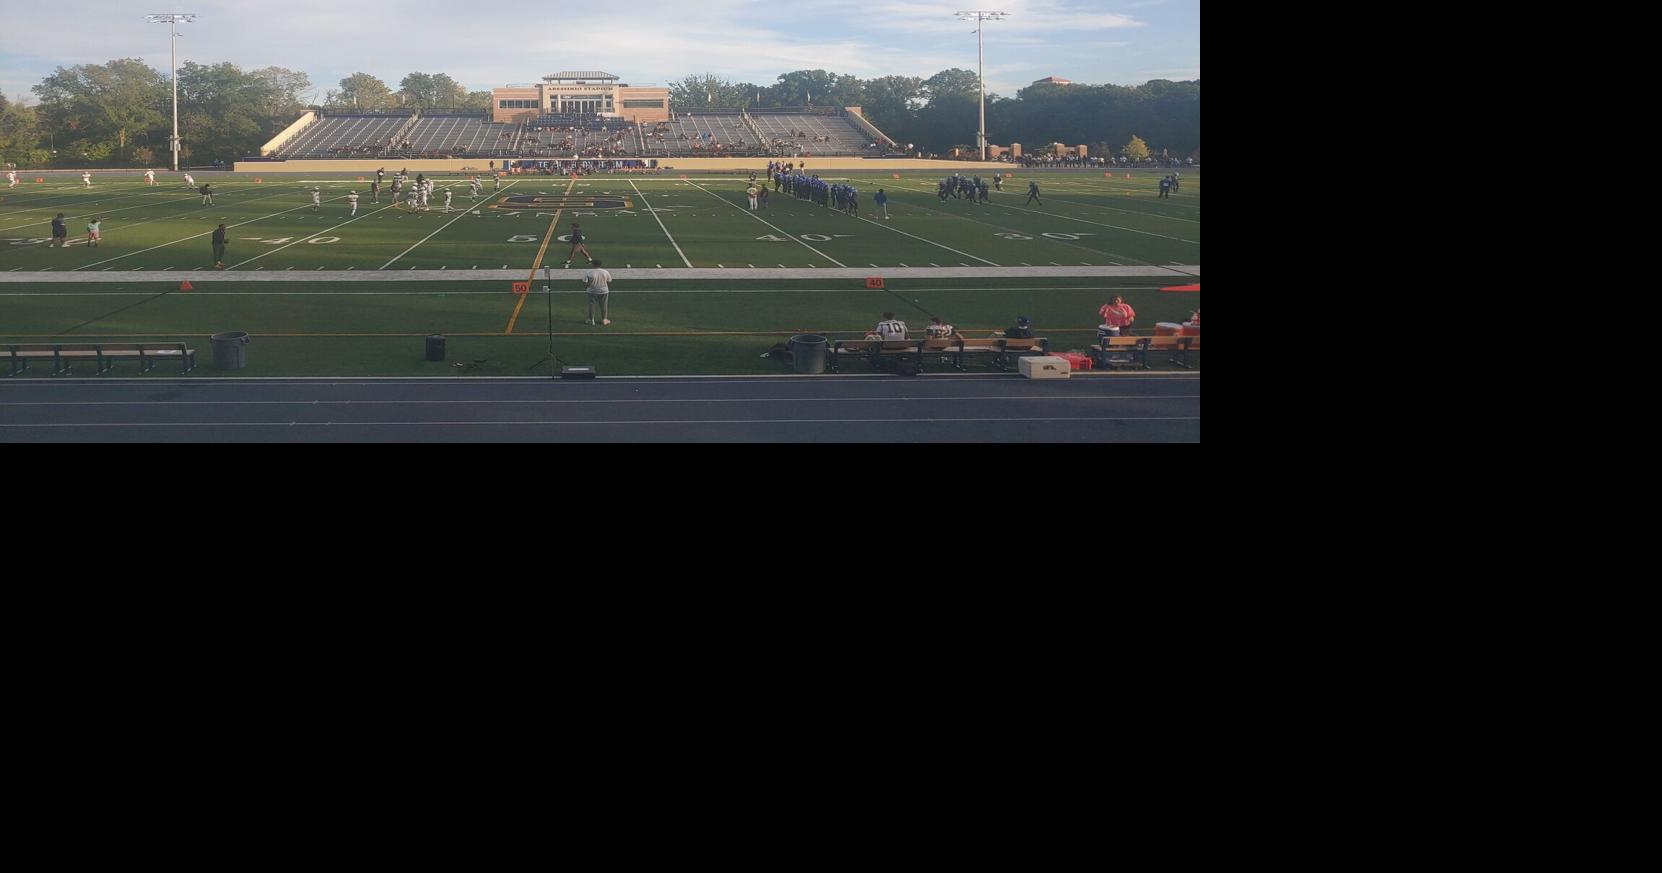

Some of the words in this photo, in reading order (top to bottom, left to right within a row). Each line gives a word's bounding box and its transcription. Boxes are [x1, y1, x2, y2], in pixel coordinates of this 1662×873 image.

[514, 283, 528, 293] 50
[868, 278, 882, 288] 40
[887, 322, 902, 334] 10
